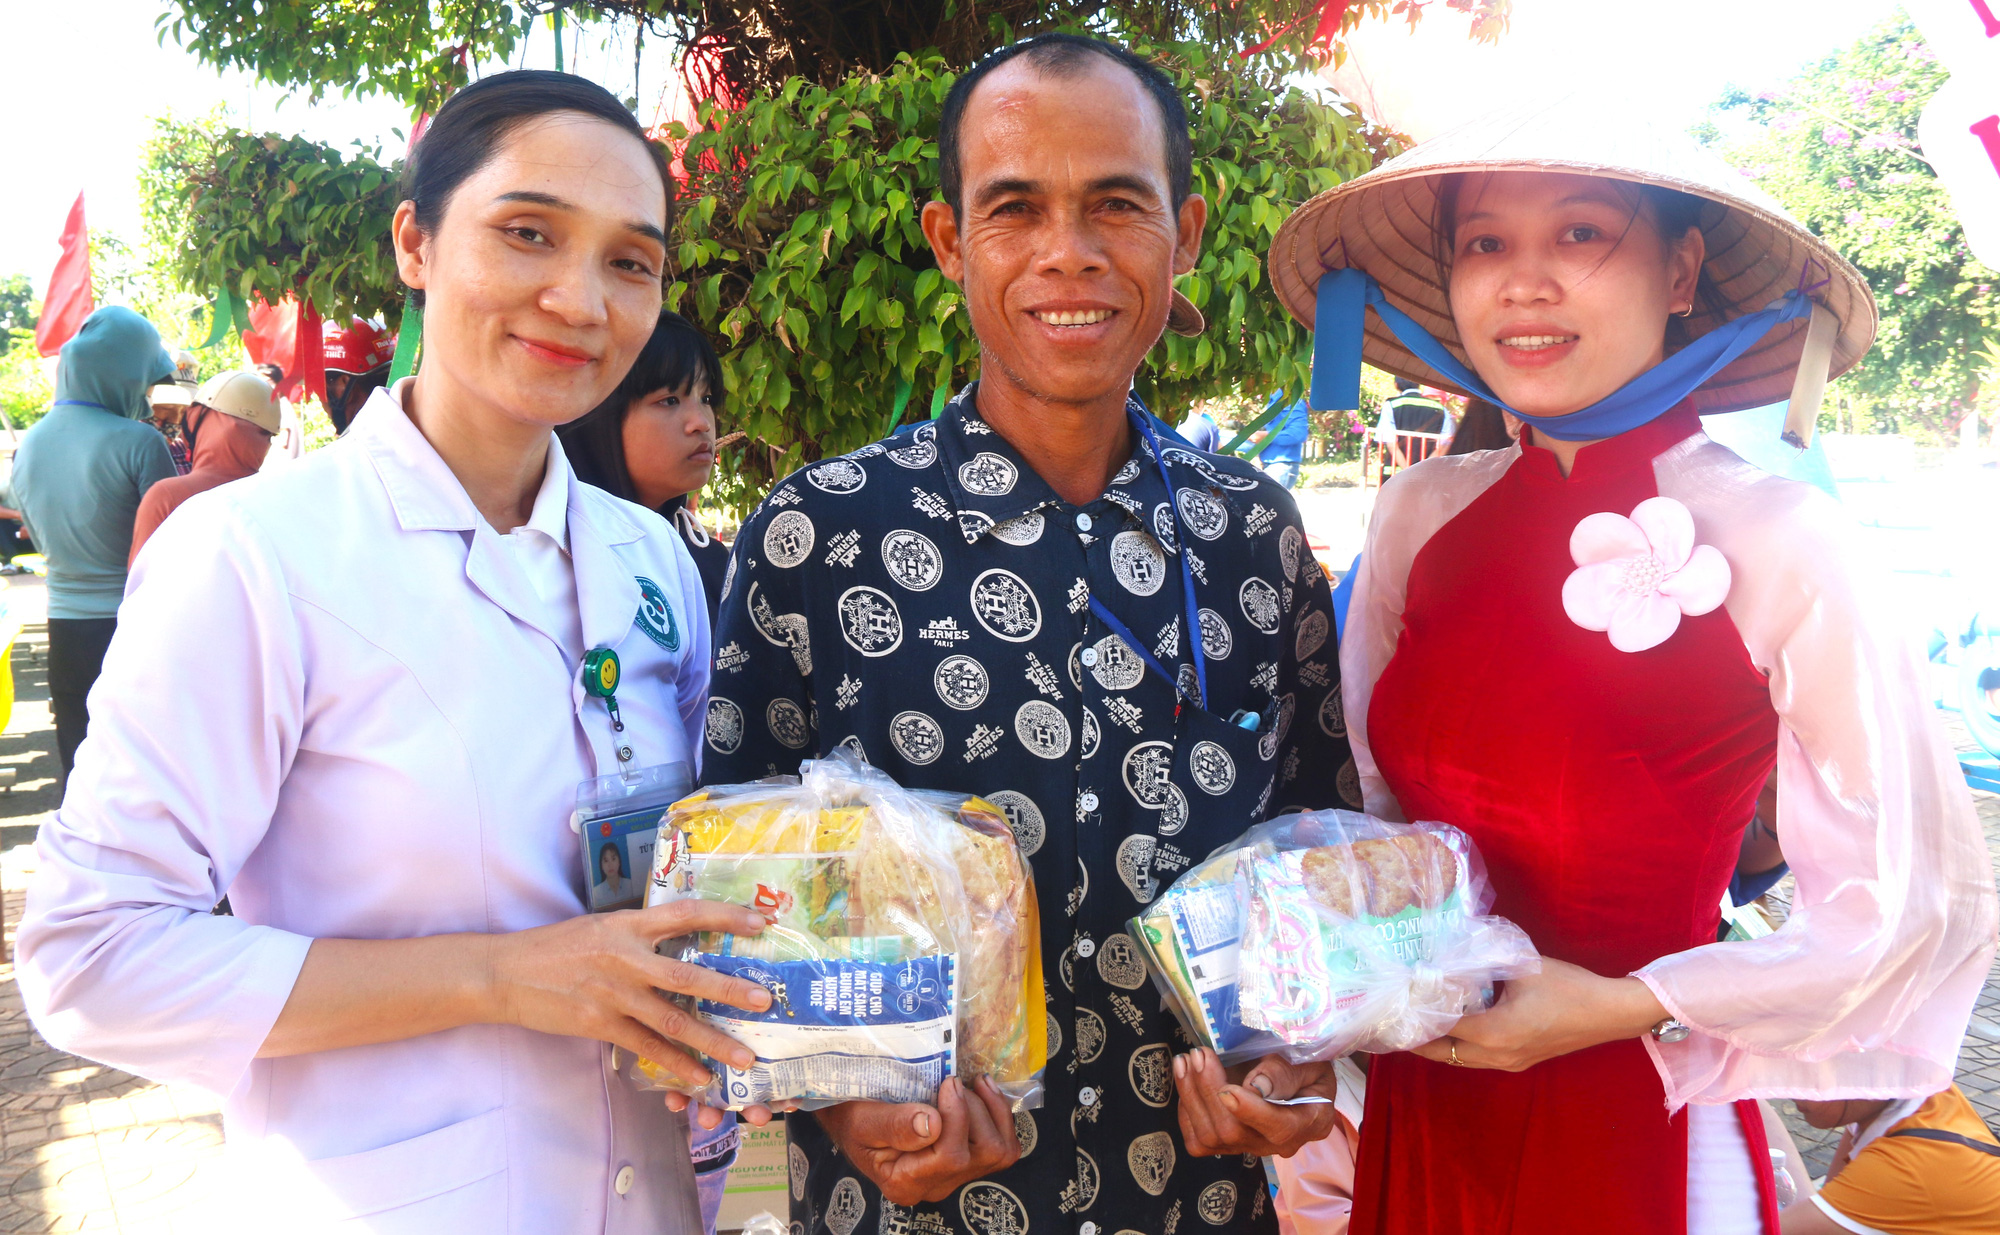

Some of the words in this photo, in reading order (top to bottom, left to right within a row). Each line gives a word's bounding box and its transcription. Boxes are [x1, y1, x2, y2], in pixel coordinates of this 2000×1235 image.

[910, 486, 954, 522] HERMES
[1243, 508, 1278, 539] HERMES
[1258, 524, 1272, 536] PARIS
[781, 534, 801, 558] H
[824, 528, 862, 568] HERMES
[905, 558, 920, 577] H
[1131, 560, 1150, 583] H
[985, 594, 1007, 616] H
[868, 608, 891, 634] H
[918, 628, 970, 640] HERMES
[934, 640, 954, 648] PARIS
[716, 650, 750, 671] HERMES
[1105, 646, 1123, 666] H
[962, 676, 977, 692] H
[1025, 651, 1064, 702] HERMES
[1298, 668, 1330, 687] ERMES
[1102, 696, 1144, 734] HERMES
[915, 731, 931, 748] H
[962, 726, 1004, 764] HERMES
[1034, 726, 1052, 746] H
[980, 745, 998, 760] PARIS
[1154, 848, 1191, 867] HERME
[1135, 866, 1150, 889] H
[1114, 944, 1132, 964] H
[870, 996, 882, 1016] CHO
[1107, 992, 1145, 1036] HERMES
[1112, 1007, 1128, 1025] PARIS
[839, 1190, 852, 1210] H
[972, 1201, 992, 1223] H
